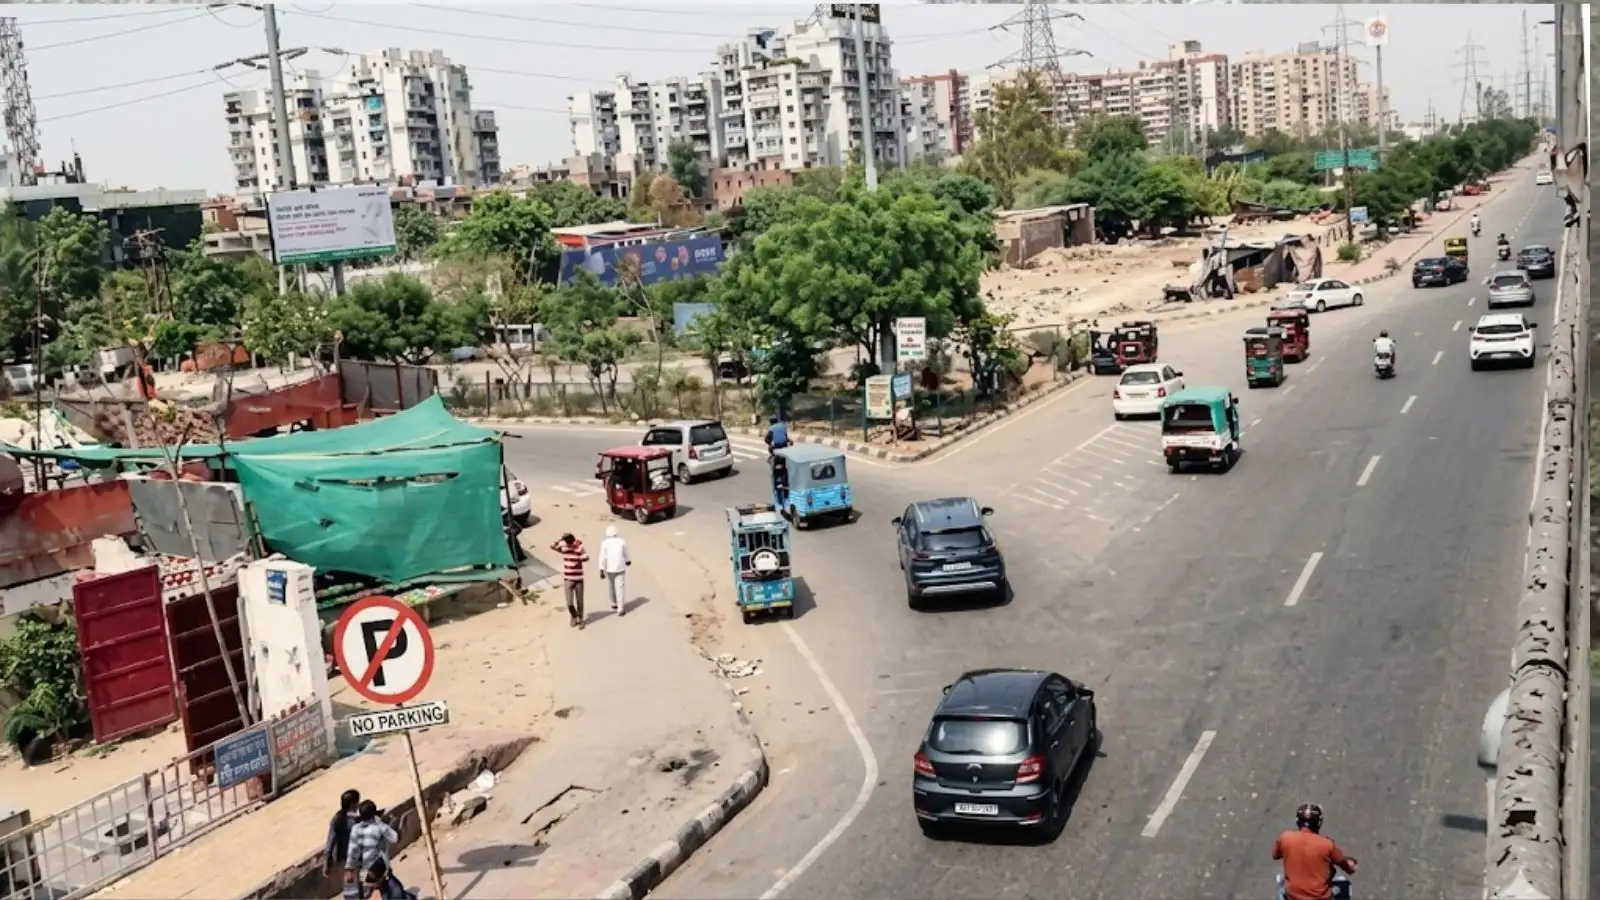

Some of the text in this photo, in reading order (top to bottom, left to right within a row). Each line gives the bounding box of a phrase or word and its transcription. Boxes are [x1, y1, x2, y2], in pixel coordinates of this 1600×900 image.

[360, 619, 408, 687] P
[352, 706, 443, 733] NO PARKING
